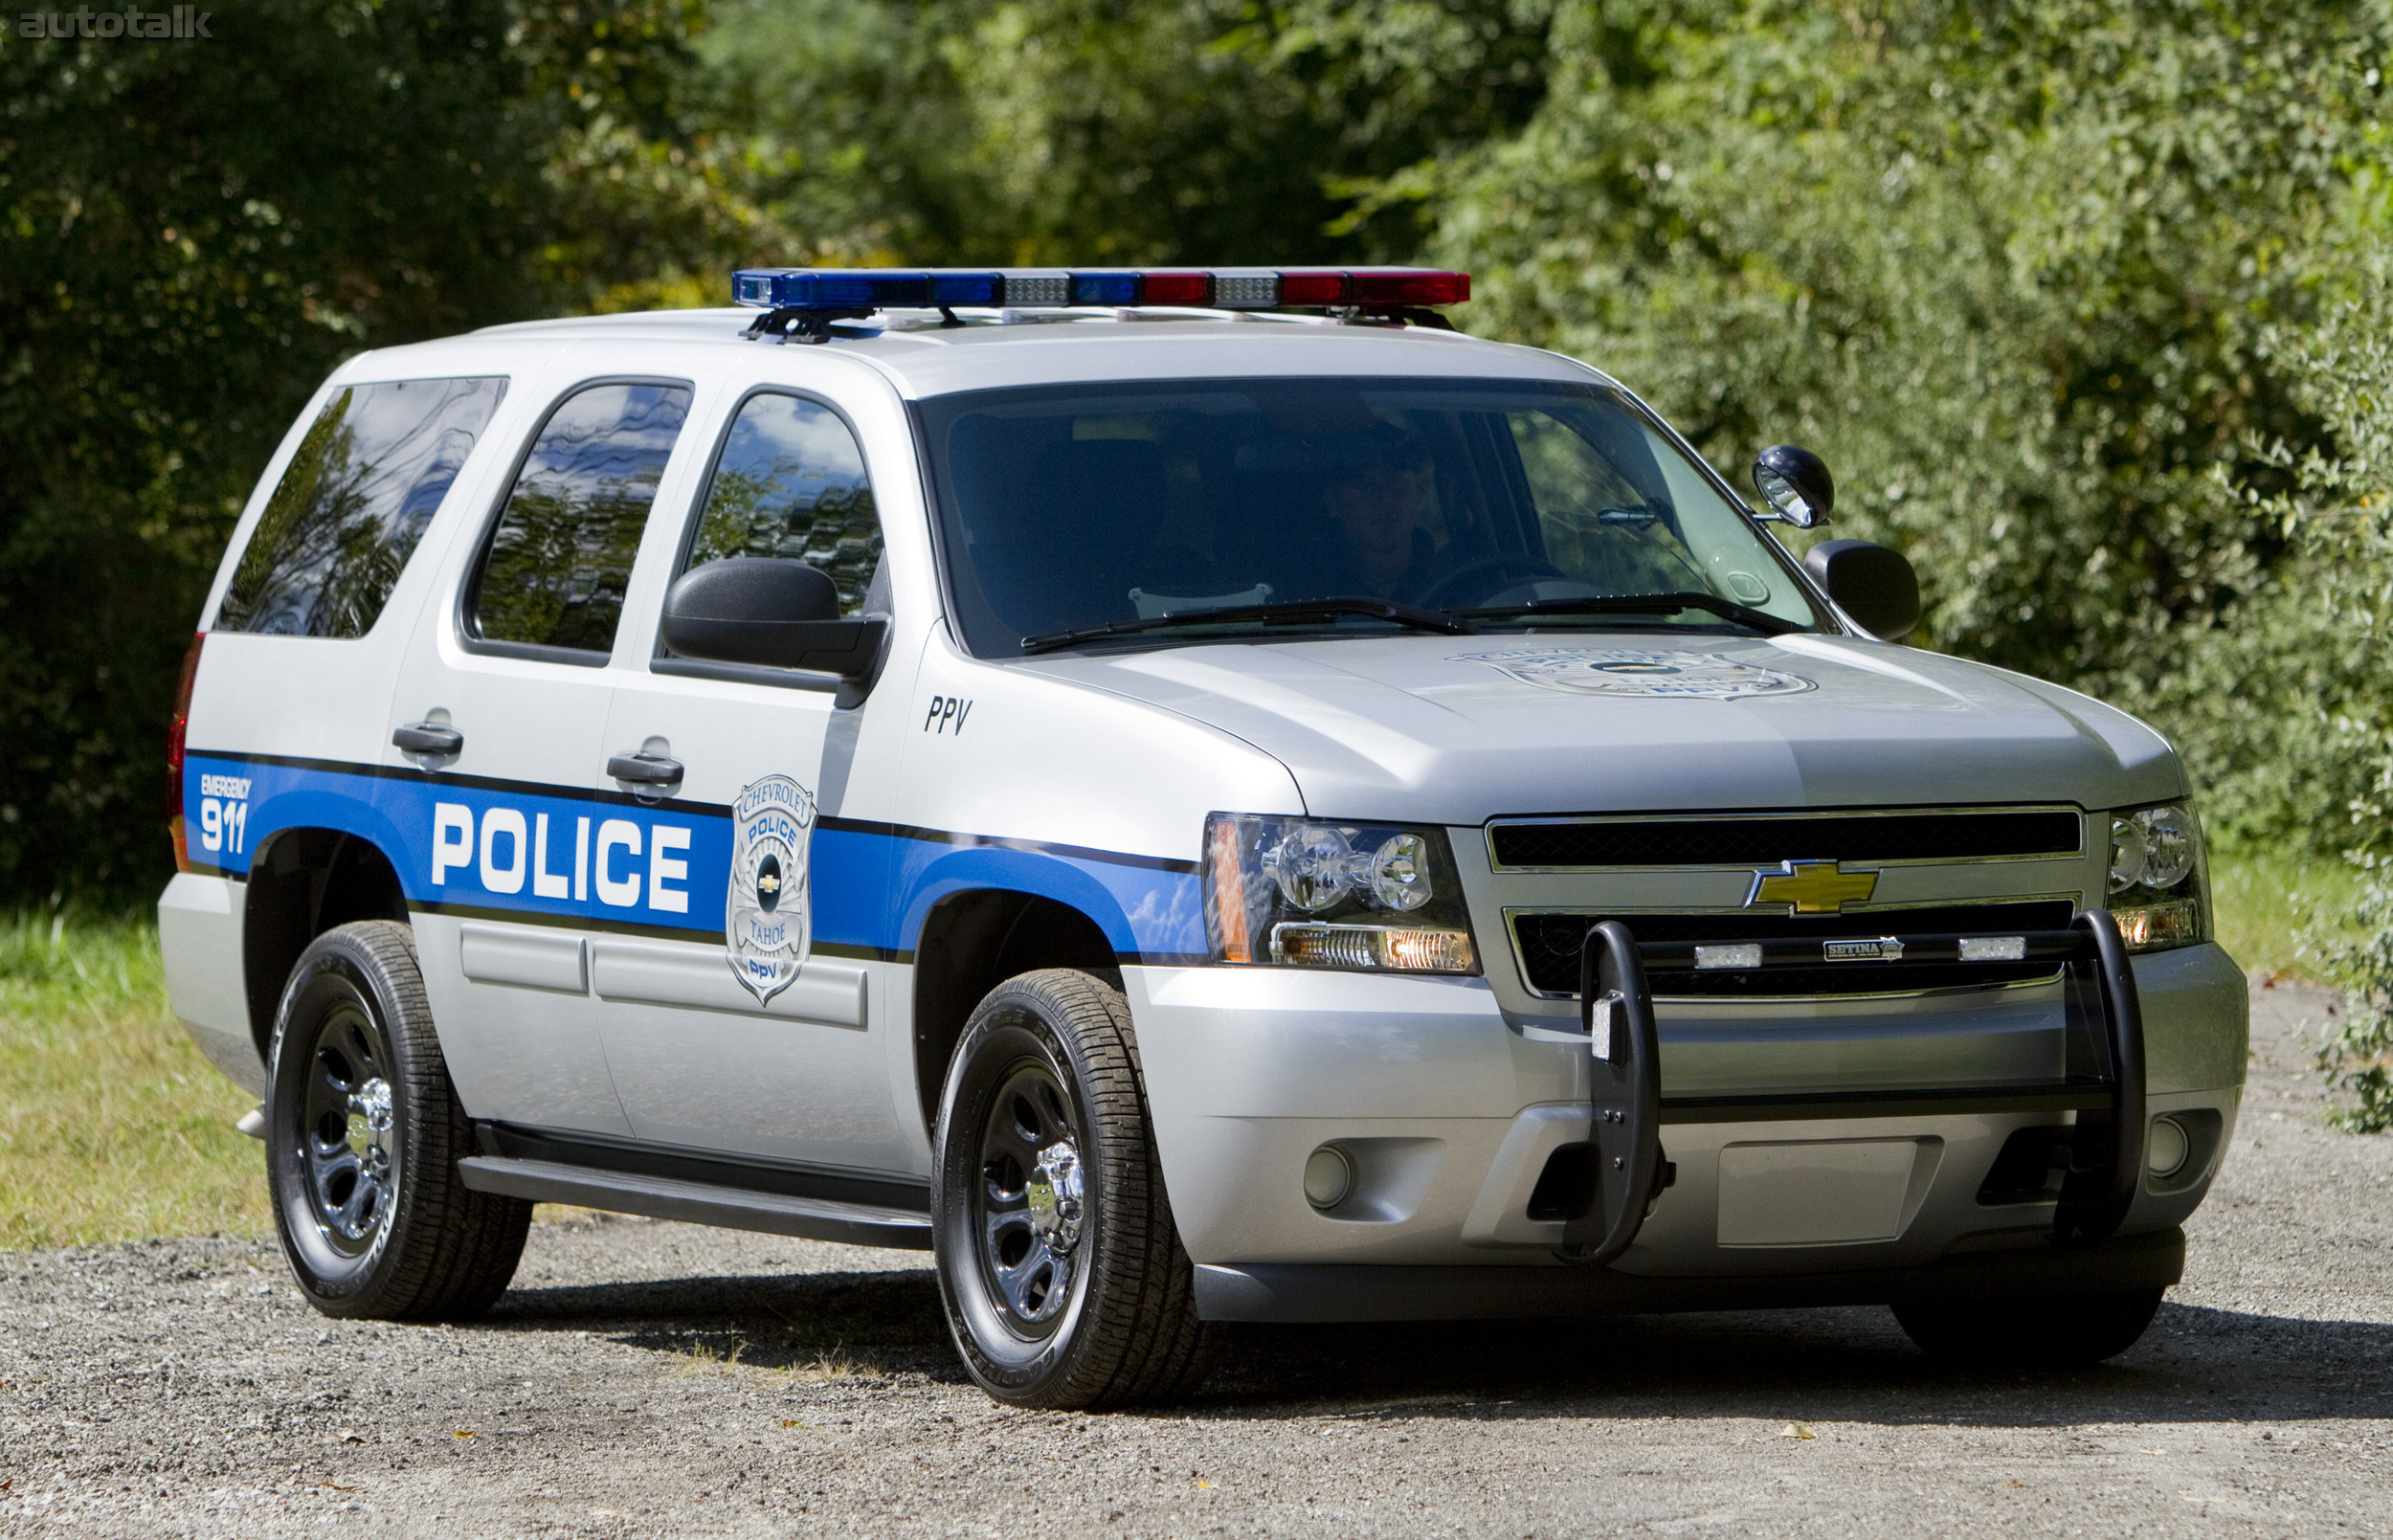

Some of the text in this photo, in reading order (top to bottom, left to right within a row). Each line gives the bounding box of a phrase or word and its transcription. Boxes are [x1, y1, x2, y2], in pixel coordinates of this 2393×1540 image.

[925, 695, 973, 736] PPV
[201, 773, 252, 800] EMERGENCY
[743, 783, 807, 820] CHEVROLET
[201, 797, 248, 855] 911
[748, 816, 797, 848] POLICE
[432, 802, 691, 914] POLICE
[749, 919, 785, 946] TAHOE
[1828, 943, 1881, 954] SETINA
[749, 958, 777, 980] PPV
